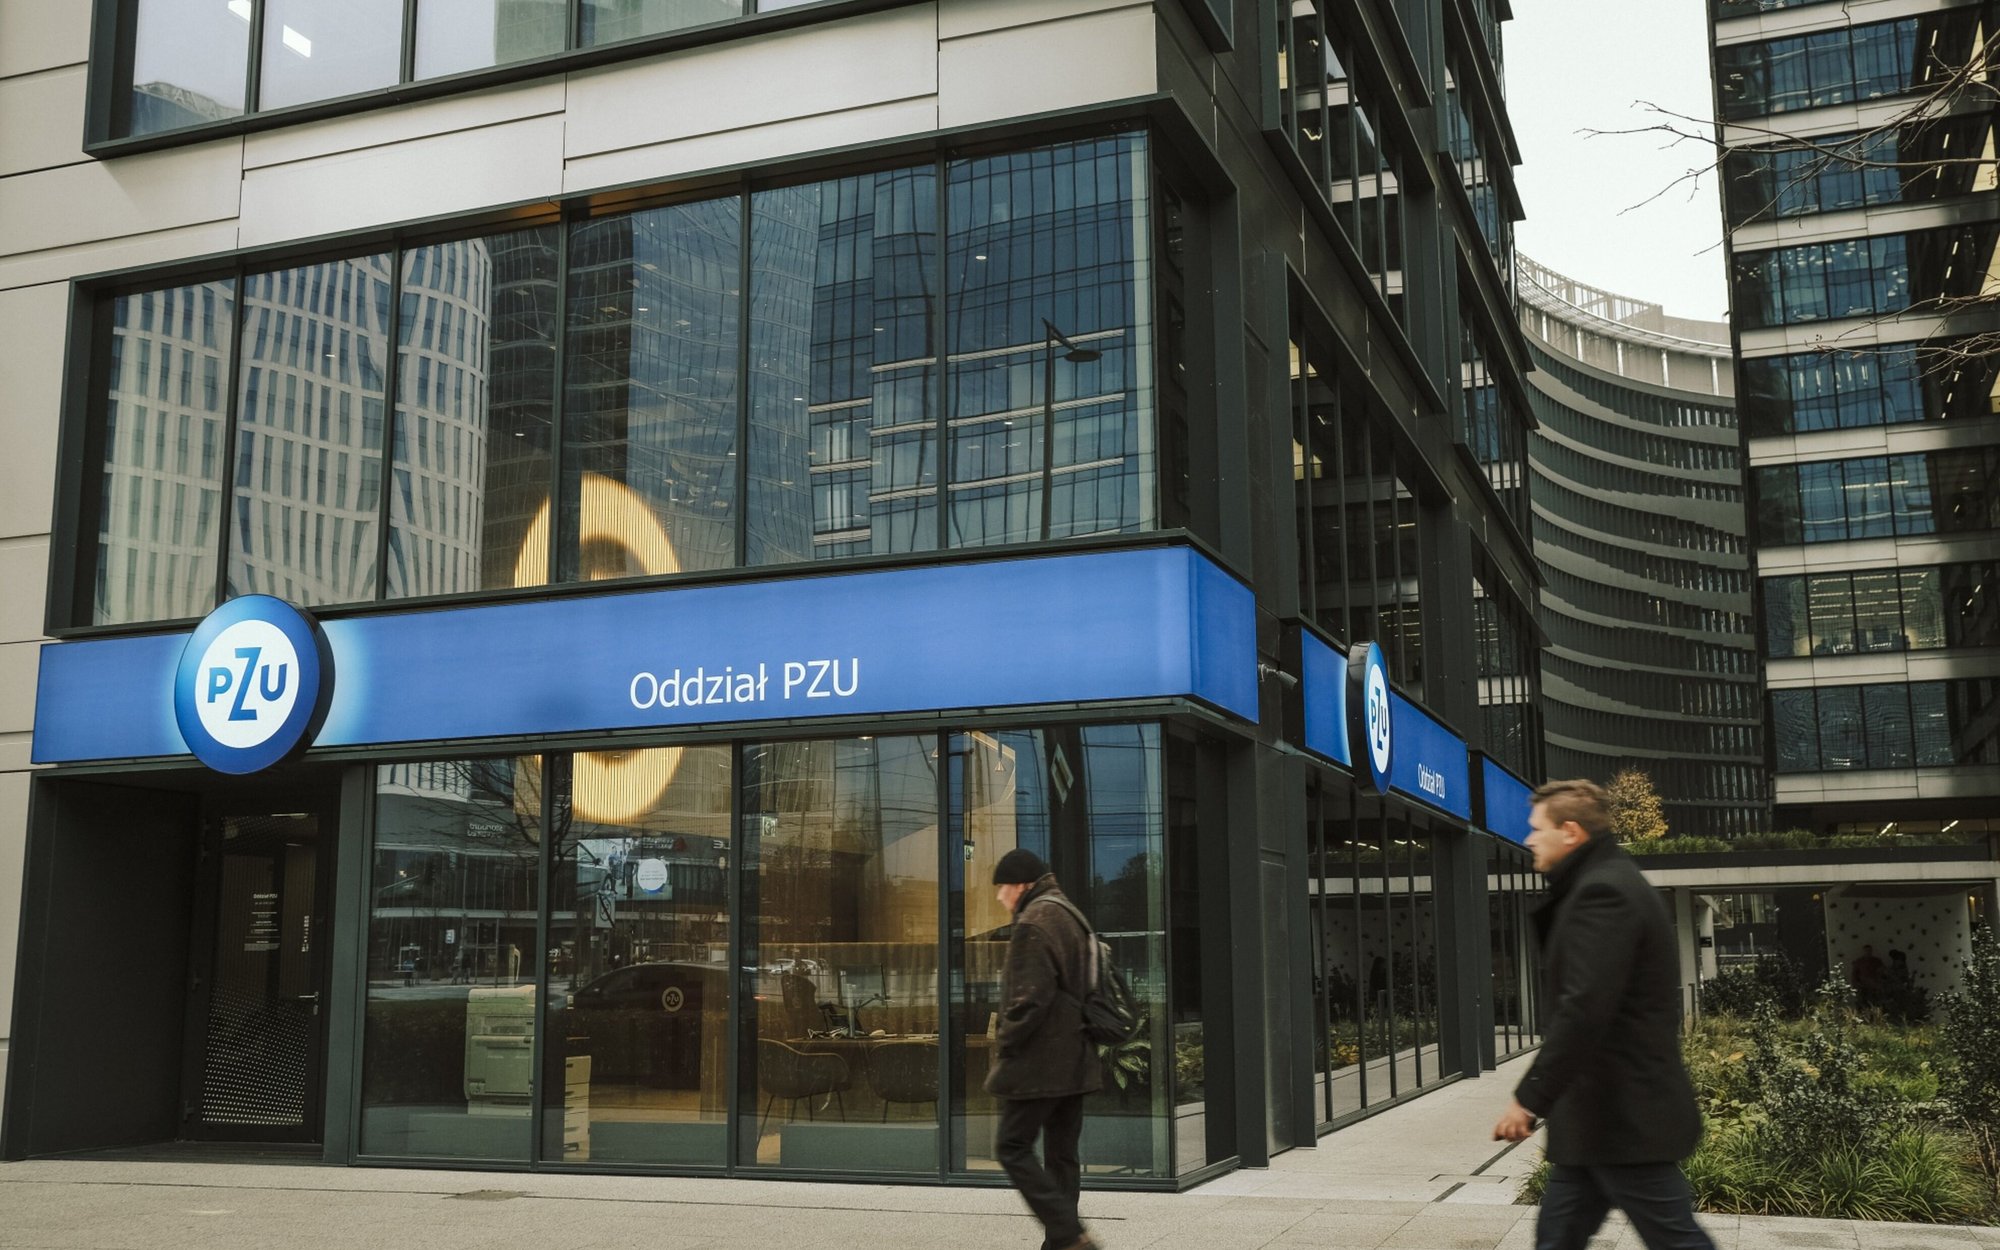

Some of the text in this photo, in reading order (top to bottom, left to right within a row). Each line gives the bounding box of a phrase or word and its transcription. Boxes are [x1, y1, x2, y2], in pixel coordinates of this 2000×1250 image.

[207, 646, 287, 721] PZU
[630, 657, 859, 709] Oddział PZU
[1371, 687, 1387, 751] PZU
[1435, 773, 1445, 799] PZU
[666, 993, 680, 1005] PZU
